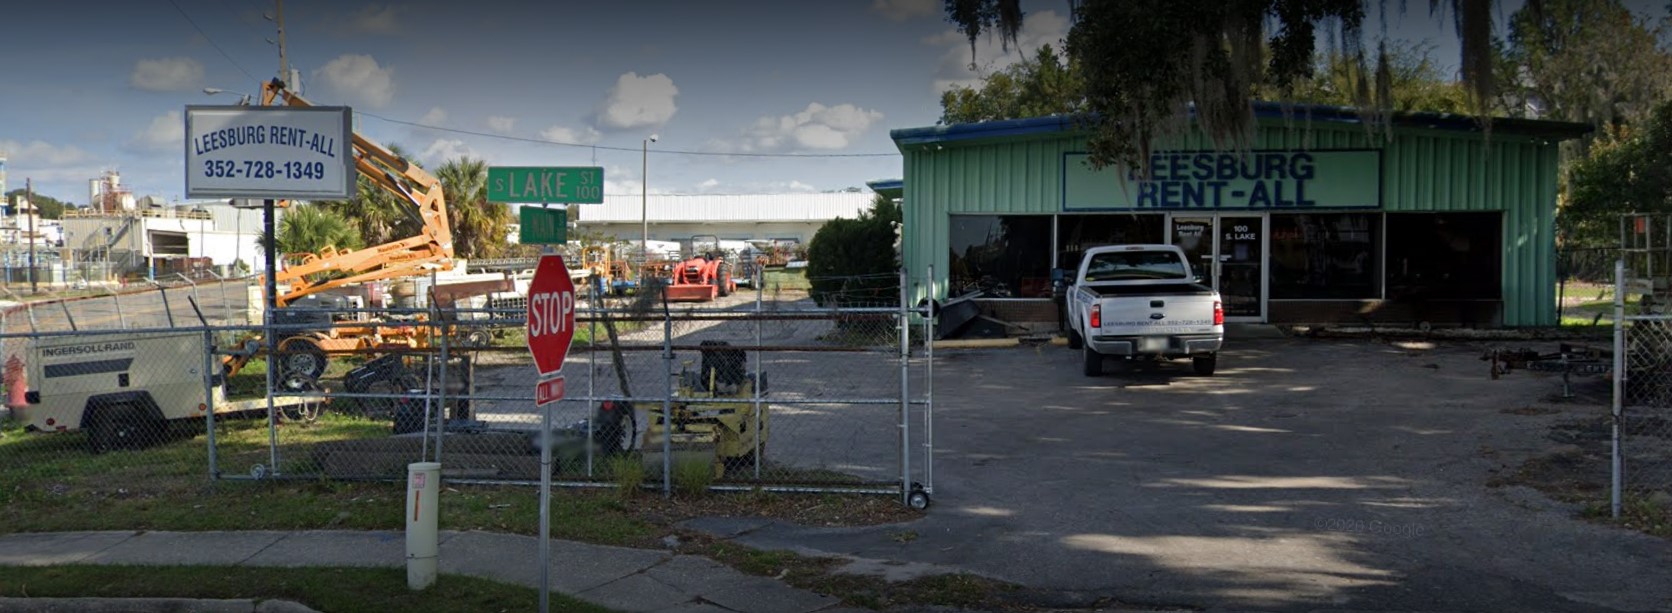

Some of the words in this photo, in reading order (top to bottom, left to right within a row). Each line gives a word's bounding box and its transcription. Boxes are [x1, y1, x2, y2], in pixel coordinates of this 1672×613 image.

[195, 125, 265, 156] LEESBURG
[270, 125, 335, 158] RENT-ALL
[204, 160, 325, 180] 352-728-1349
[581, 171, 594, 184] ST
[1128, 153, 1314, 180] EESBURG
[495, 178, 504, 192] S
[509, 172, 568, 198] LAKE
[576, 186, 600, 199] 100
[1136, 181, 1315, 208] RENT-ALL
[530, 291, 573, 338] STOP
